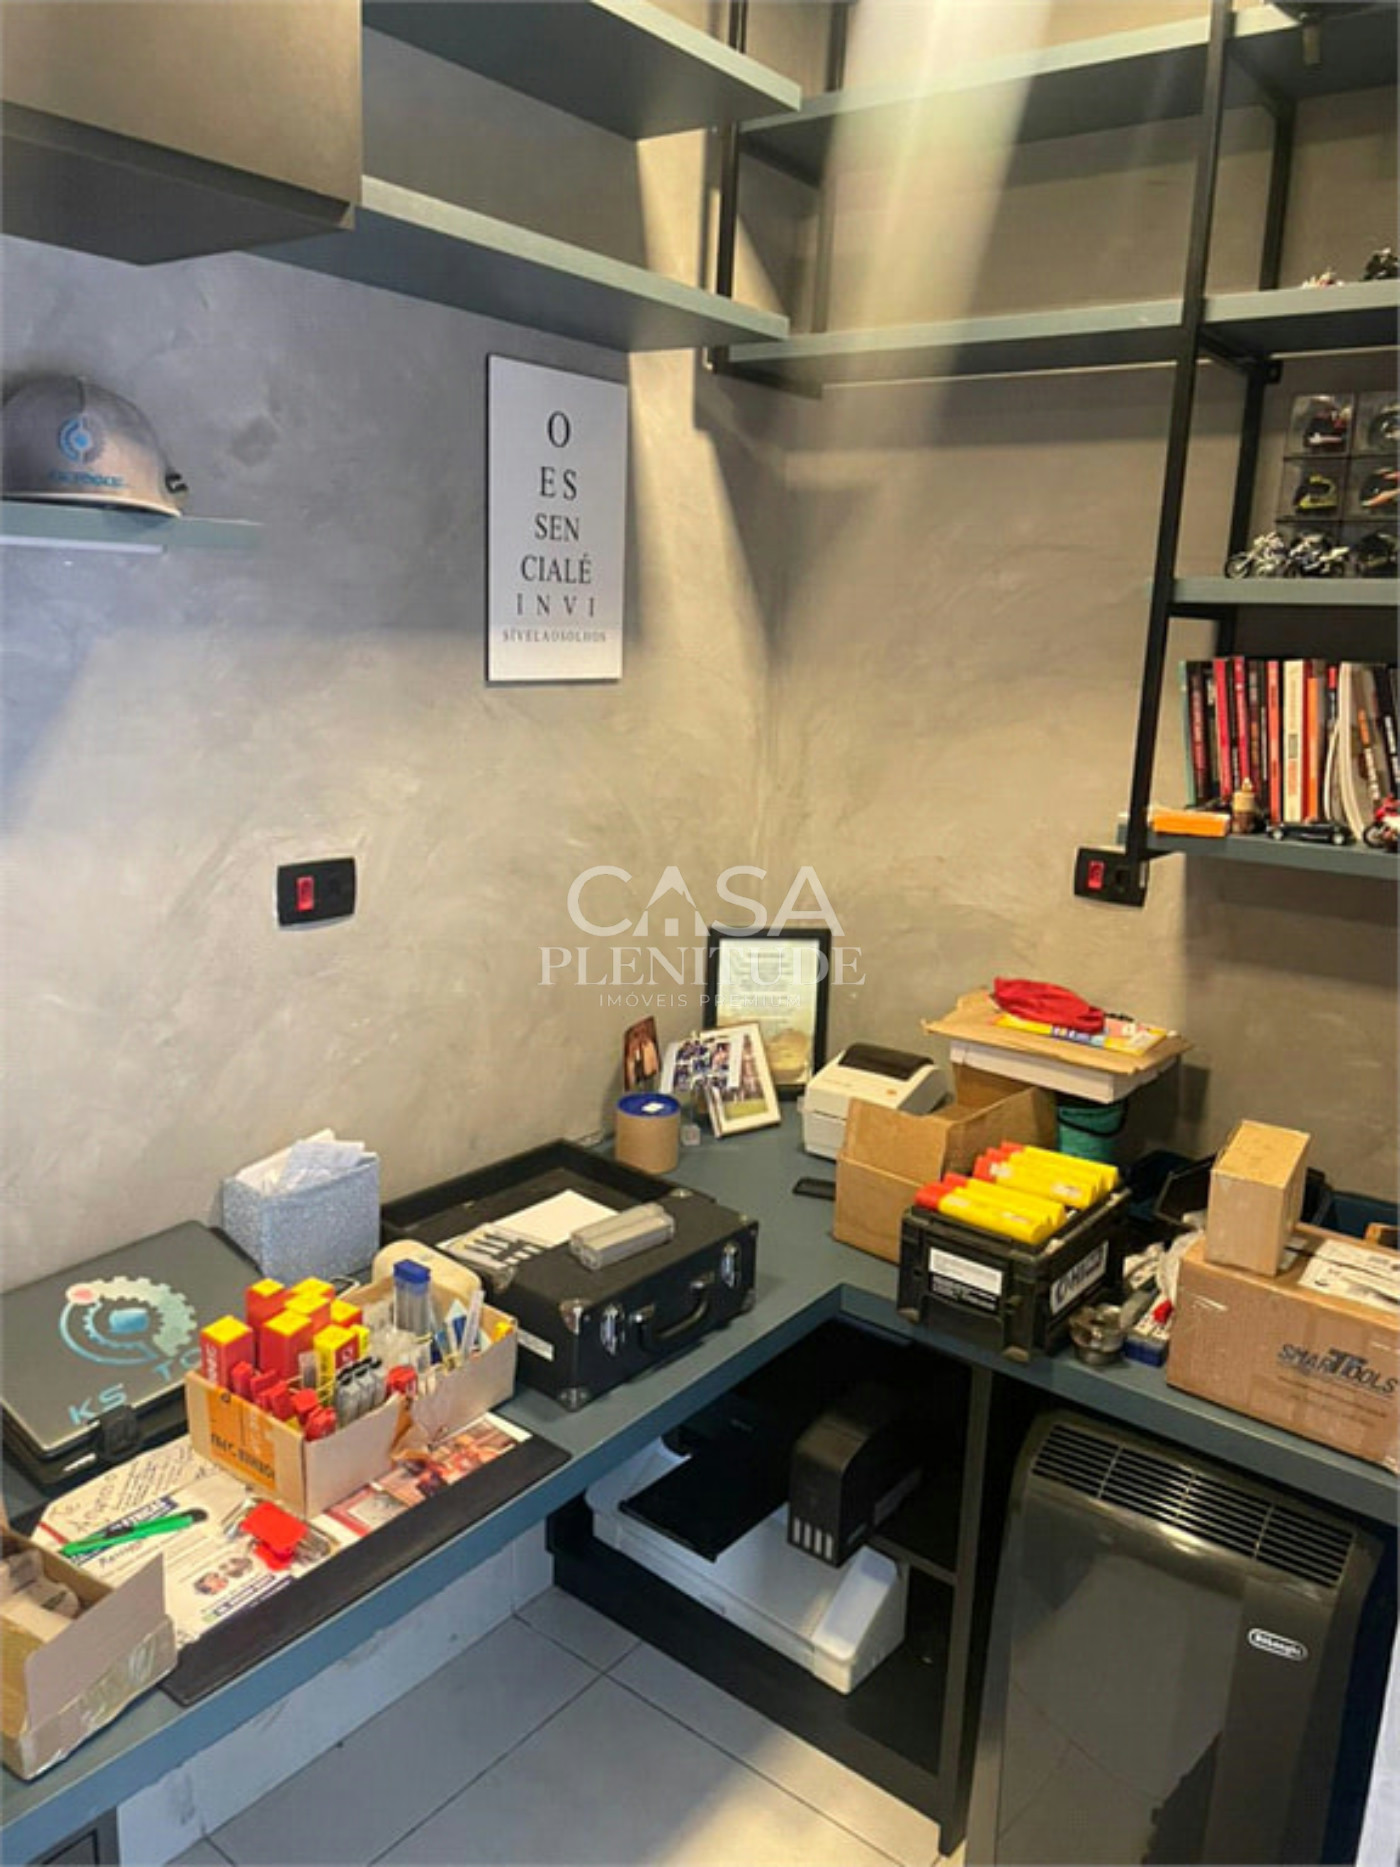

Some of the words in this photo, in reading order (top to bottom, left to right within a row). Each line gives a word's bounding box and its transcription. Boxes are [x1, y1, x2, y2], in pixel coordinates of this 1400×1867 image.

[547, 410, 571, 448] O
[540, 466, 577, 501] ES
[534, 513, 579, 542] SEN
[521, 553, 592, 584] CIALÉ
